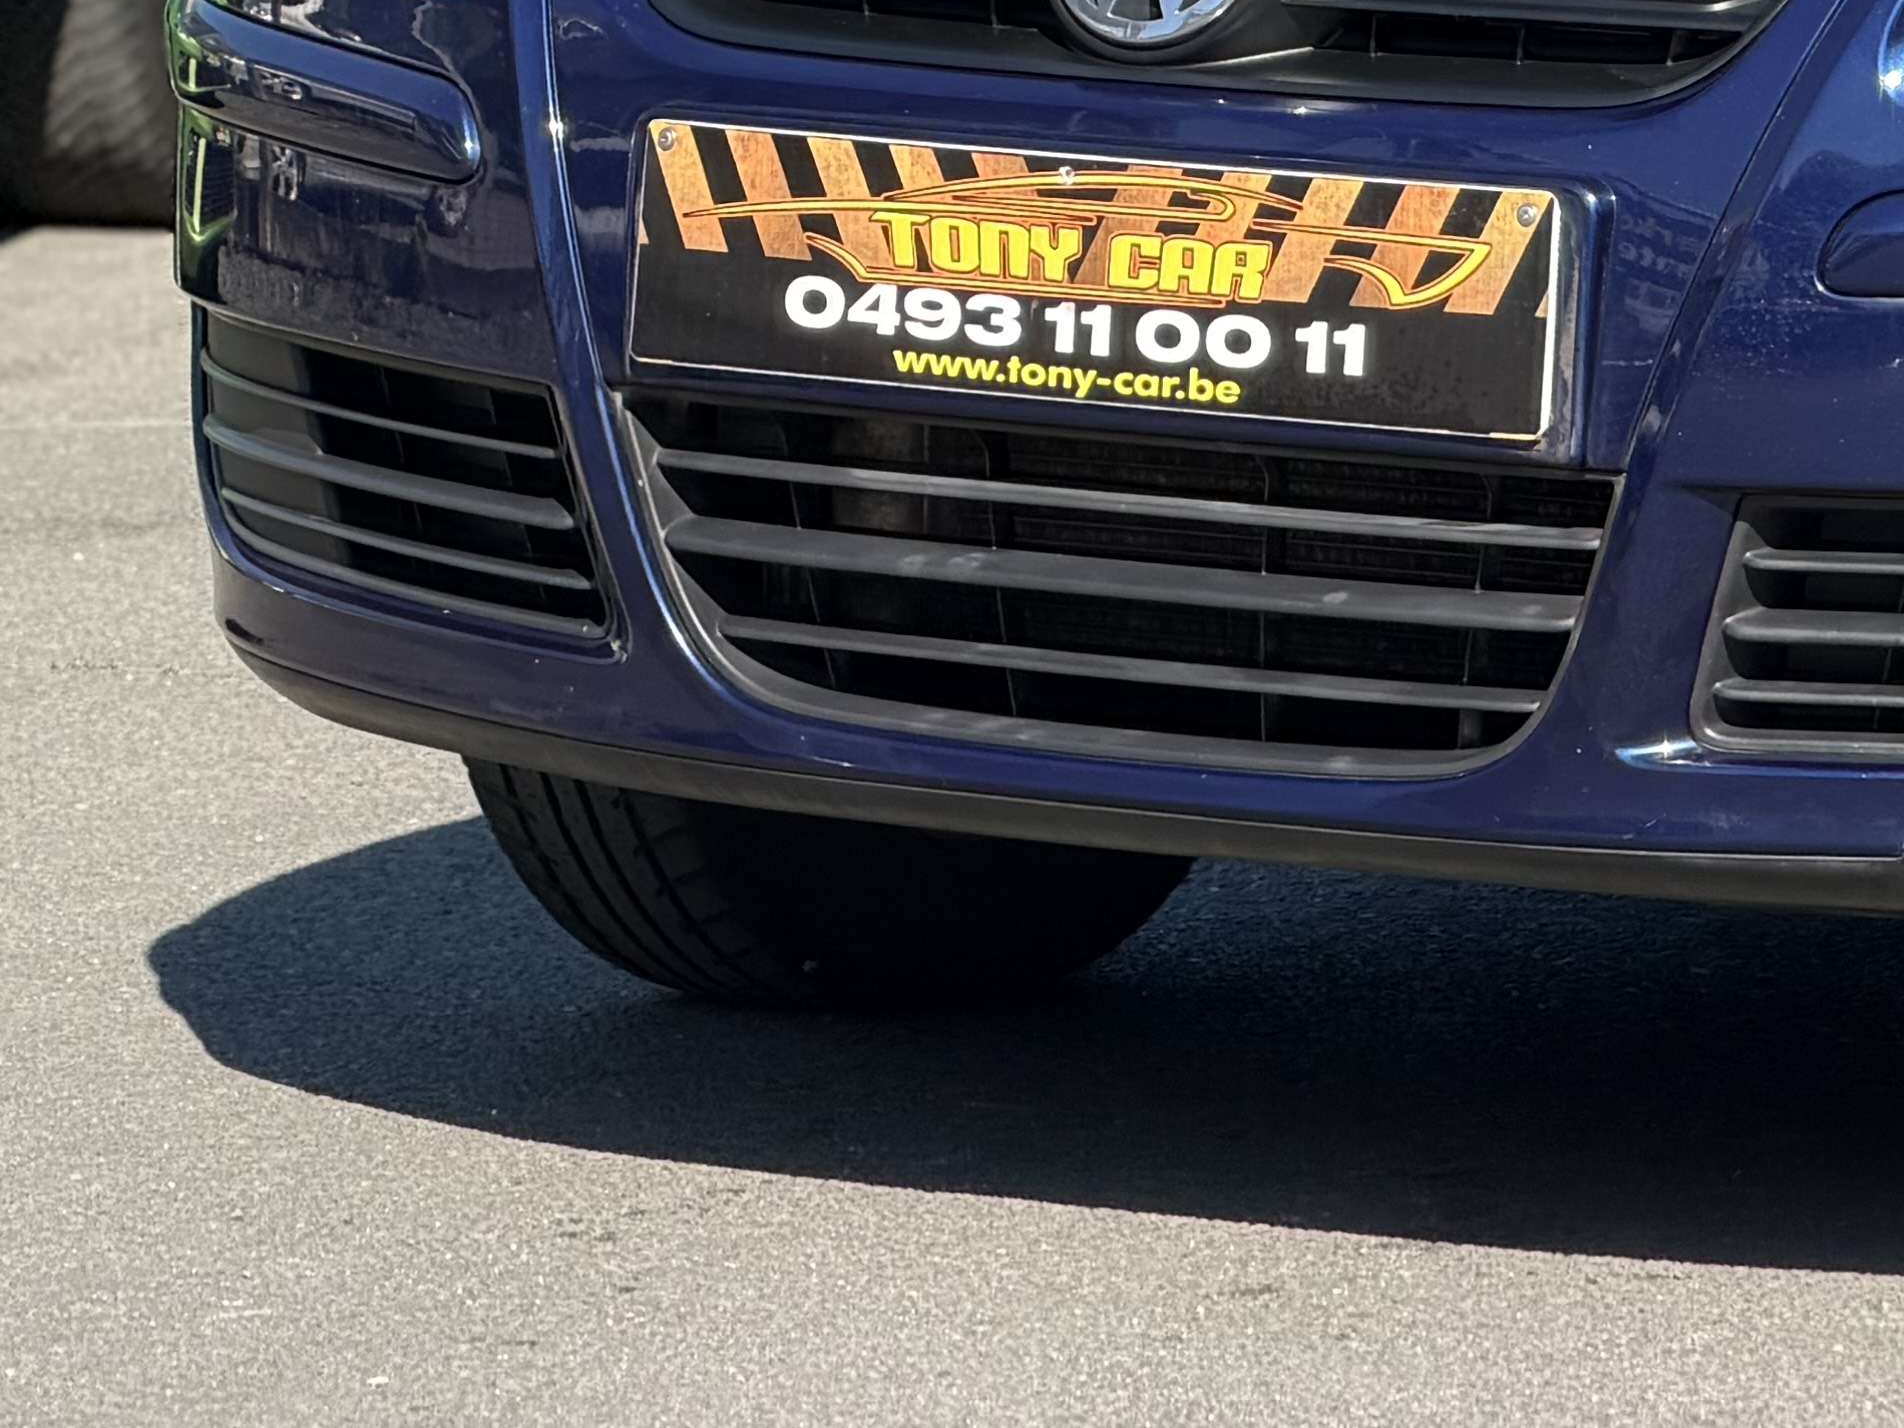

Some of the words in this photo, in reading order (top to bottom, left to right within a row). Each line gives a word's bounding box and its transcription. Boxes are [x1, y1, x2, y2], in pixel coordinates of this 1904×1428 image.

[869, 210, 1083, 282] TONY
[1106, 233, 1274, 301] CAR
[784, 275, 1023, 347] 0493
[1044, 301, 1112, 358] 11
[1135, 308, 1272, 369] 00
[1295, 320, 1367, 377] 11
[892, 349, 1242, 404] www.tony-car.be
